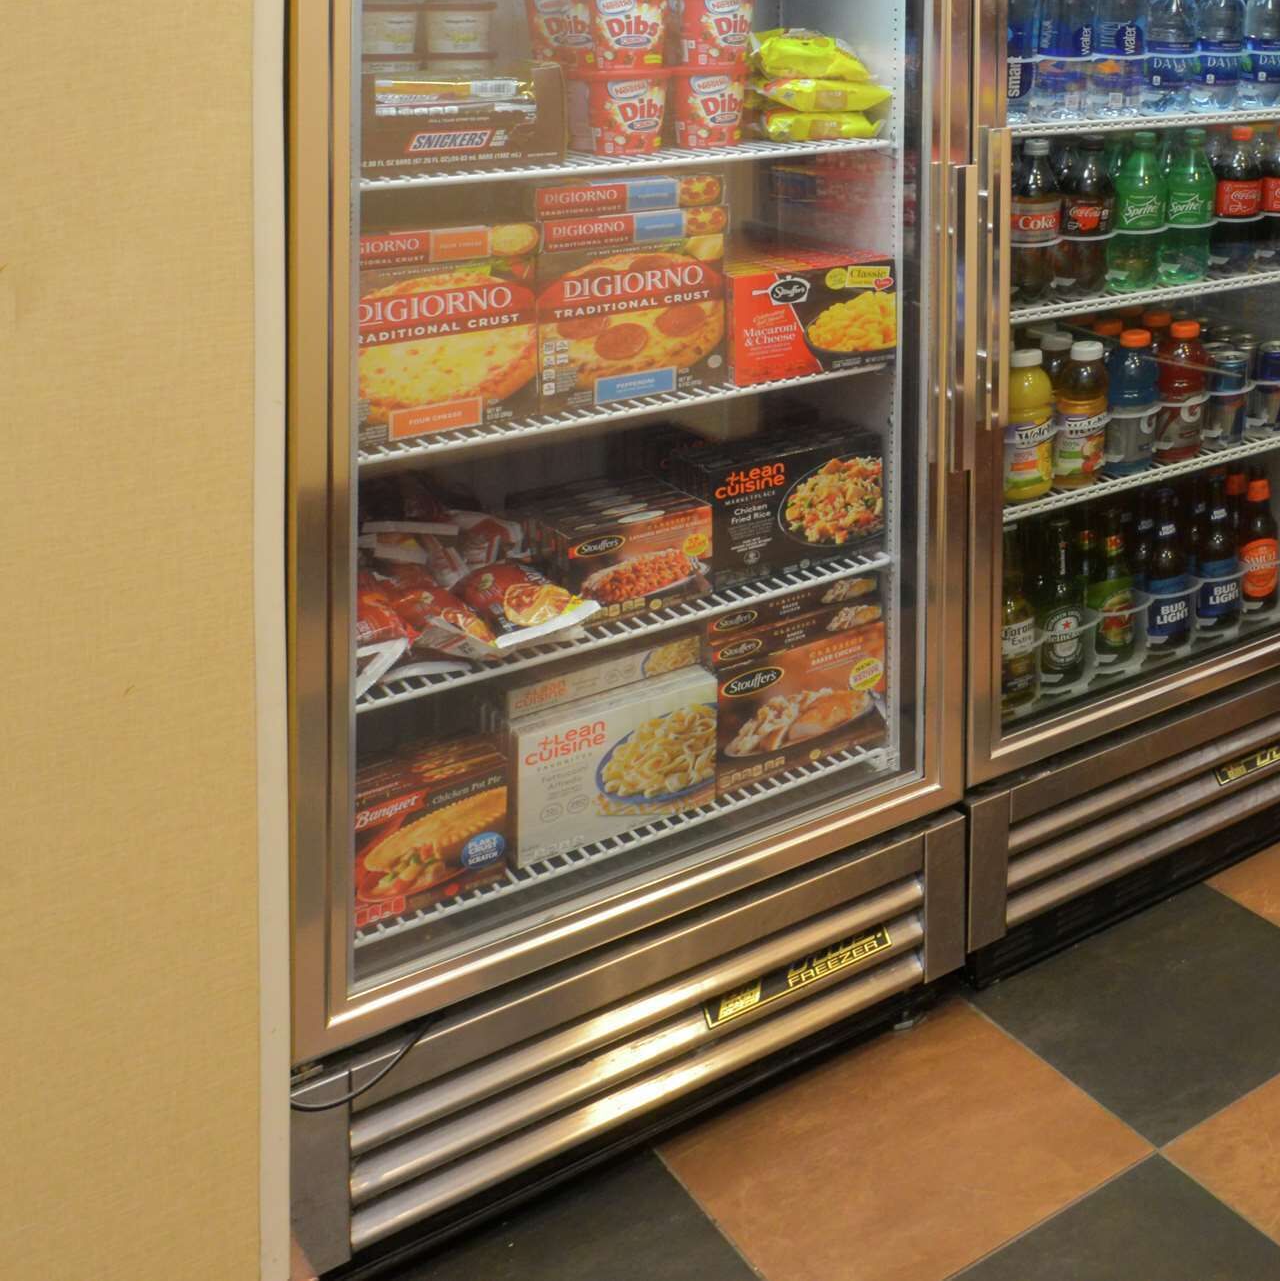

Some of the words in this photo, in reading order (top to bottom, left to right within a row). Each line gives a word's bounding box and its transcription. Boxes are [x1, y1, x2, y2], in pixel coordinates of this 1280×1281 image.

[606, 15, 660, 36] Dibs
[1080, 27, 1091, 54] water
[1124, 26, 1136, 53] water
[1008, 56, 1022, 97] smart
[413, 131, 488, 150] SNICKERS
[544, 190, 618, 204] DIGIORNO
[1126, 205, 1159, 223] Sprite
[1169, 201, 1202, 219] Sprite
[552, 221, 625, 237] DIGIORNO
[1018, 216, 1056, 231] Coke
[563, 265, 704, 302] DIGIORNO
[554, 297, 654, 318] TRADITIONAL
[656, 290, 710, 305] CRUST
[468, 314, 519, 328] CRUST
[744, 322, 797, 336] Macaroni
[745, 338, 752, 346] &
[755, 333, 796, 345] Cheese
[740, 463, 785, 482] Lean
[715, 474, 785, 499] Cuisine
[731, 515, 751, 524] Fried
[754, 511, 771, 519] Rice
[734, 504, 767, 516] Chicken
[1208, 590, 1239, 605] LIGHT
[1213, 582, 1237, 596] BUD
[1156, 608, 1189, 625] LIGHT
[1160, 601, 1186, 615] BUD
[729, 669, 778, 694] Stouffer's
[553, 721, 606, 745] Lean
[525, 734, 606, 766] Cuisine
[356, 793, 420, 828] Banquet
[787, 940, 878, 988] FREEZER
